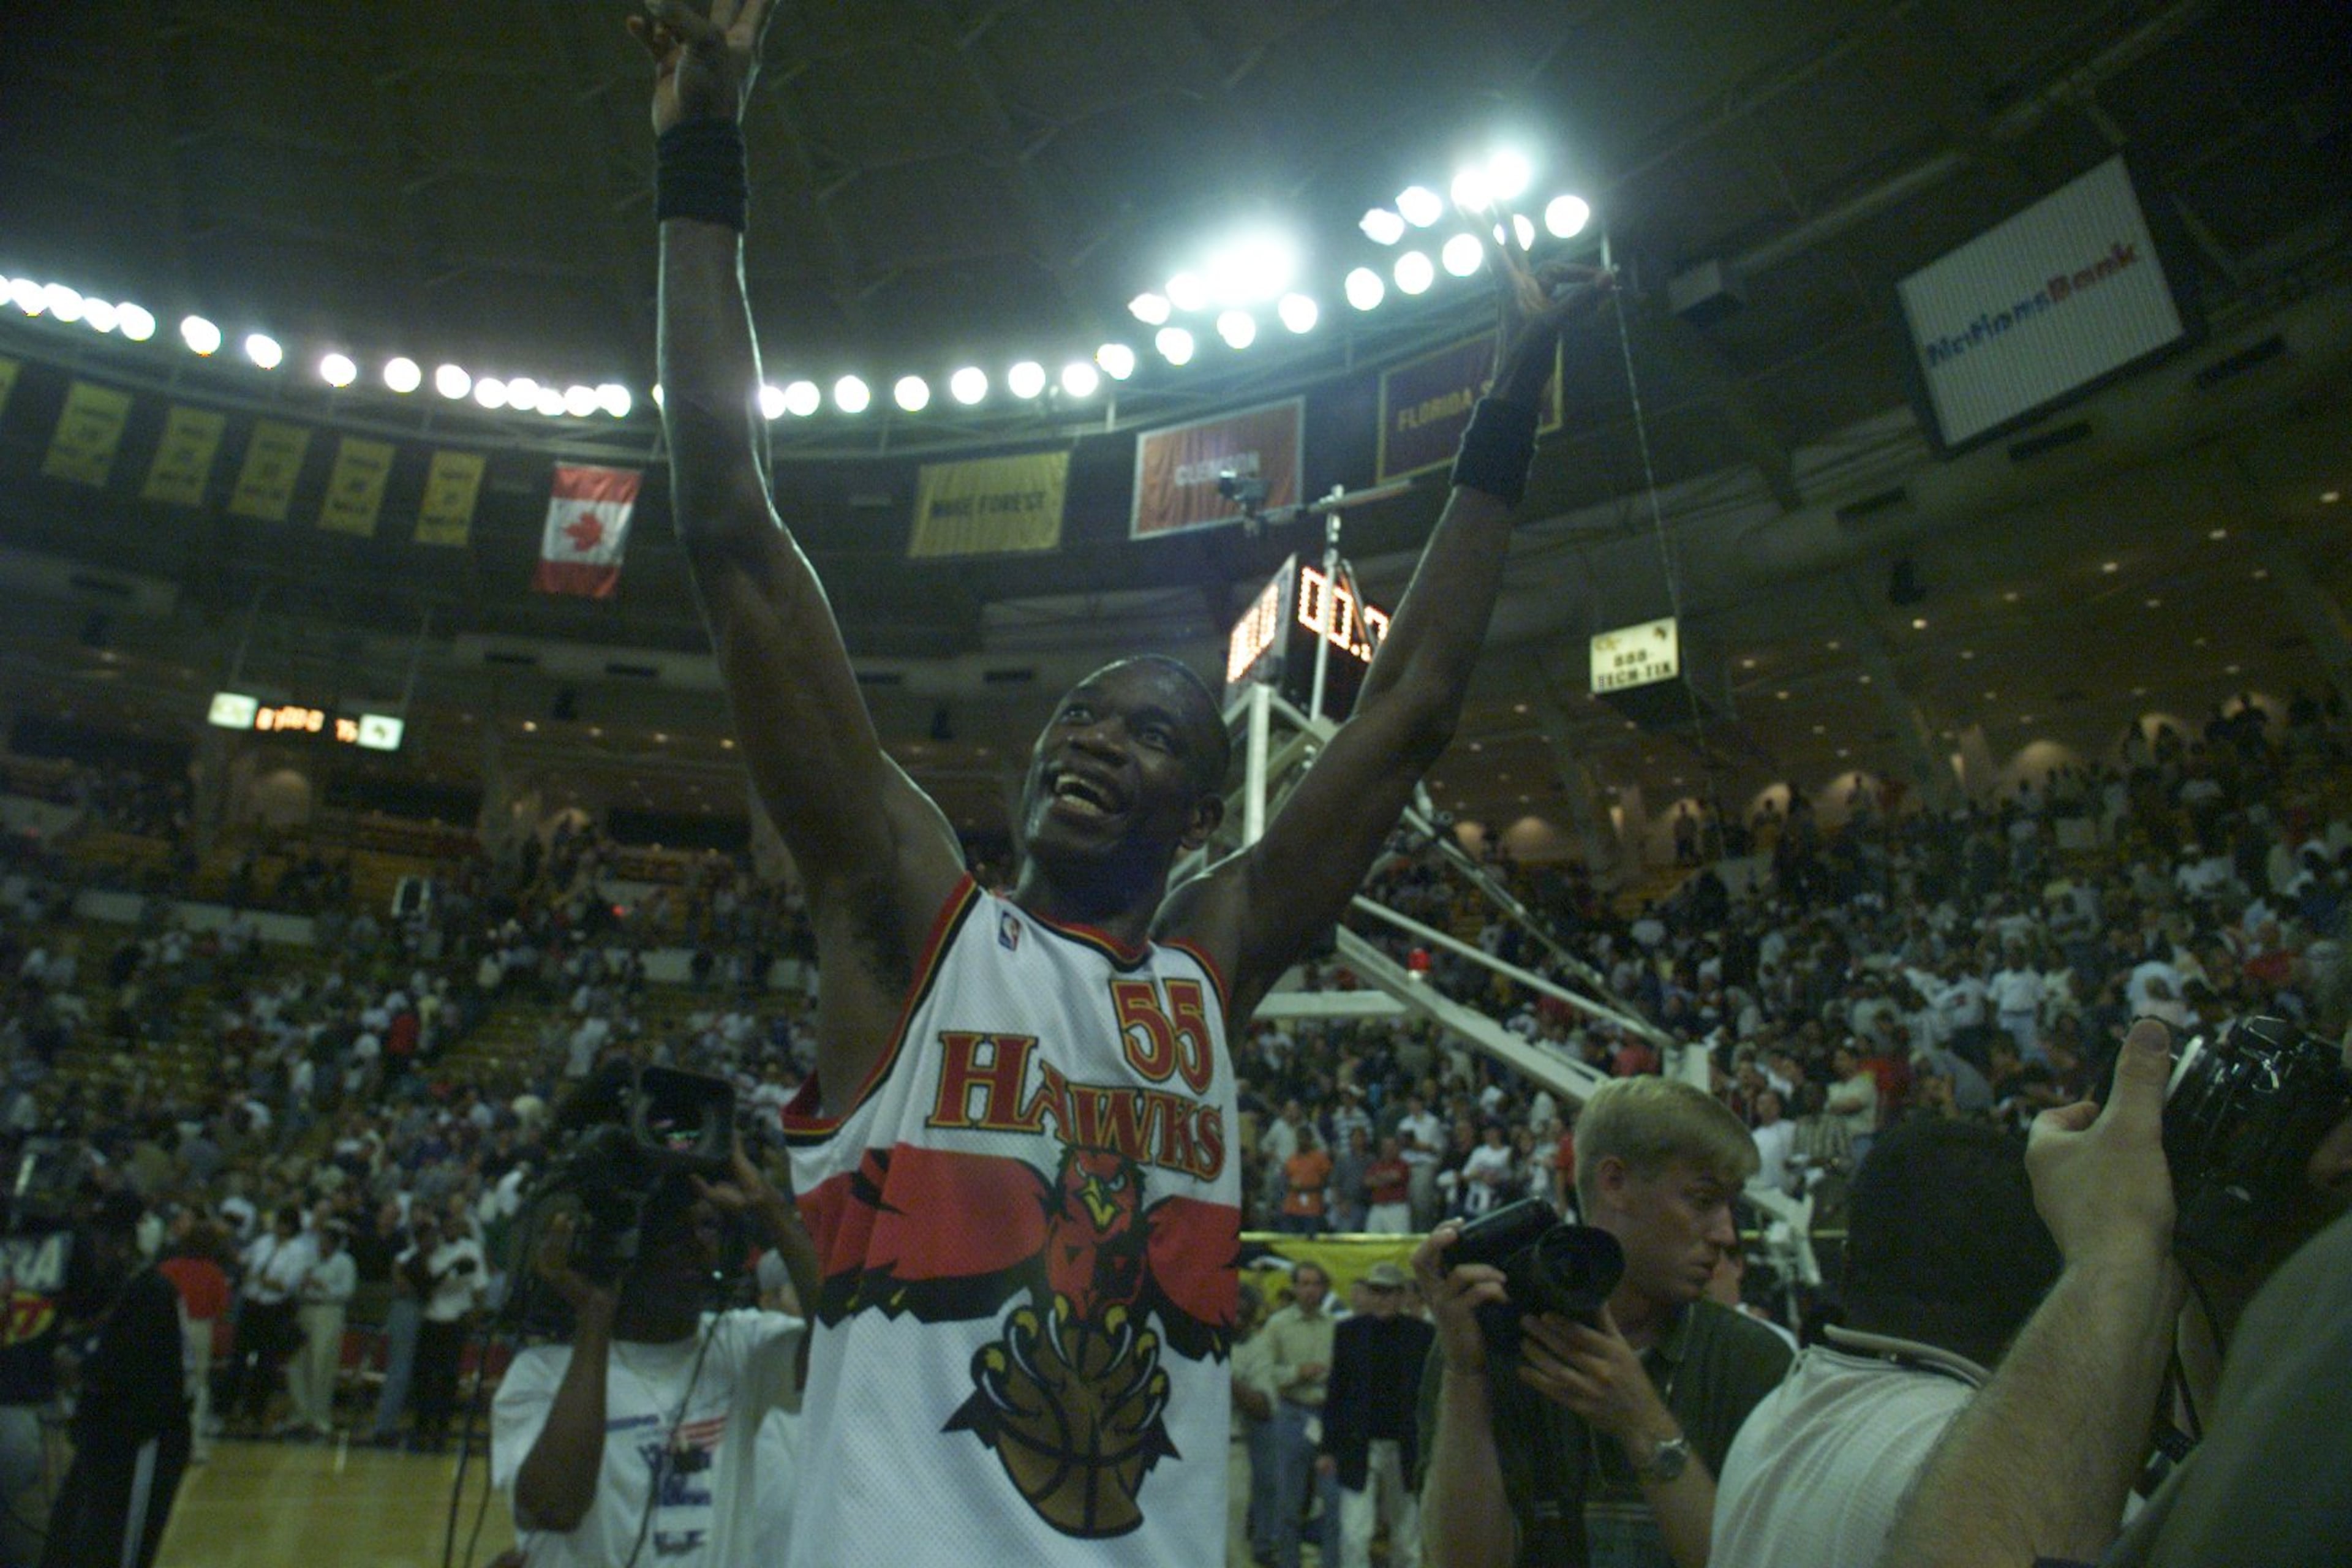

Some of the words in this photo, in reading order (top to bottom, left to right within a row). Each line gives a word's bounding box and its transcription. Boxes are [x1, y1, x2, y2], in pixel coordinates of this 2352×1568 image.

[1926, 244, 2139, 368] NationsBank
[1396, 388, 1472, 431] FLORIDA
[1109, 978, 1213, 1094] 55
[925, 1031, 1224, 1182] HAWKS
